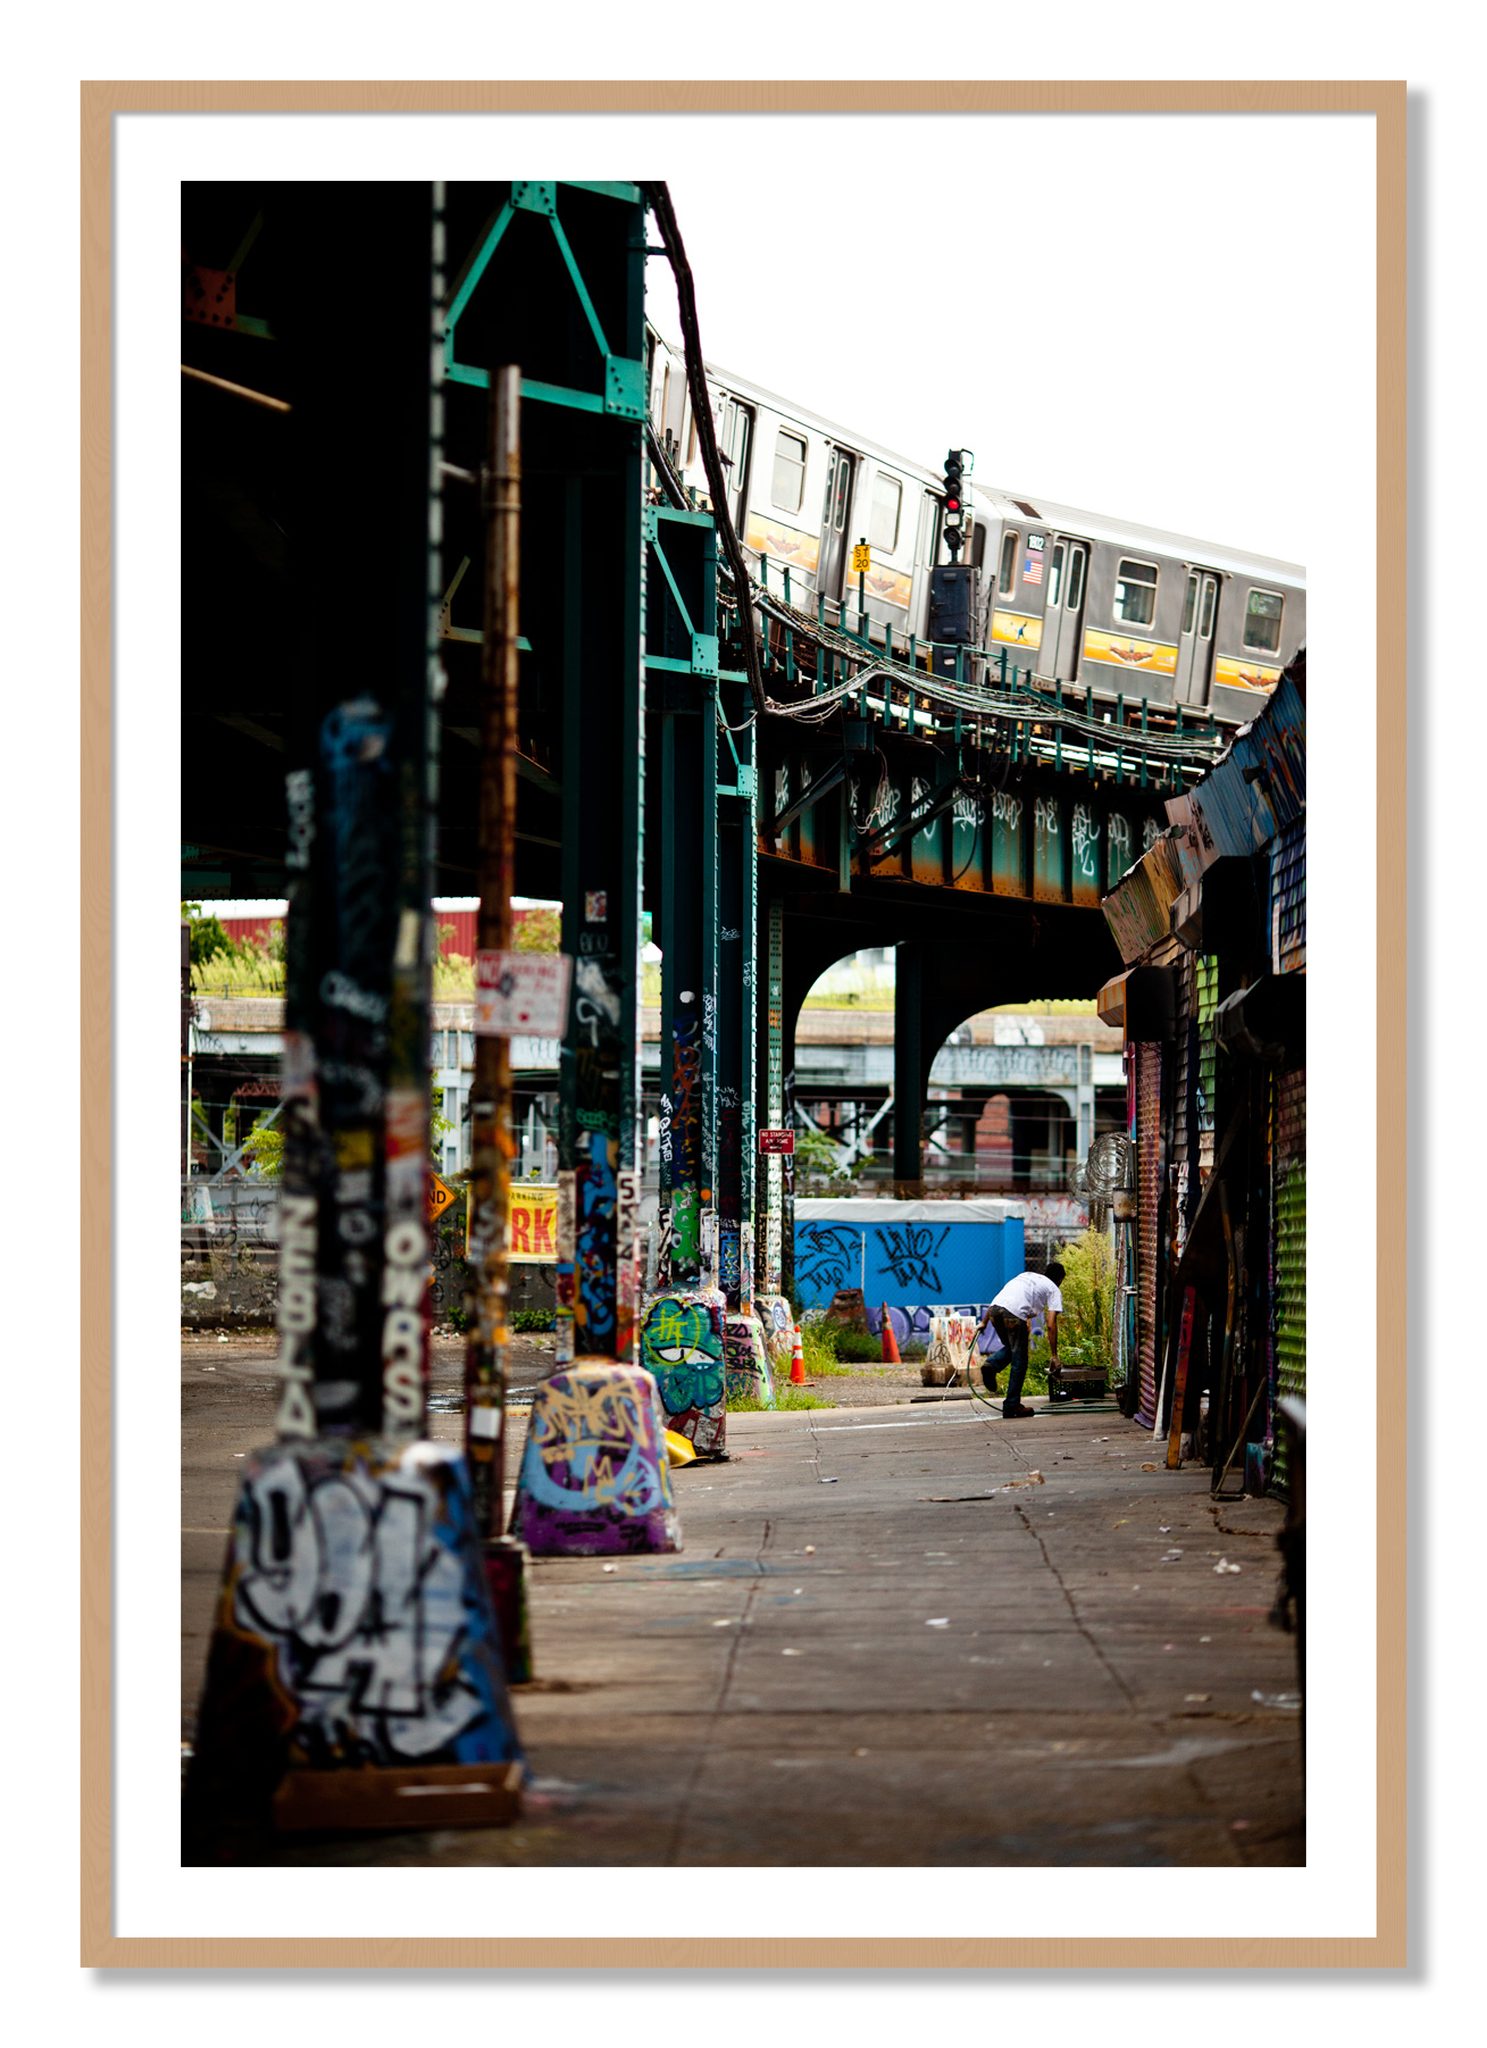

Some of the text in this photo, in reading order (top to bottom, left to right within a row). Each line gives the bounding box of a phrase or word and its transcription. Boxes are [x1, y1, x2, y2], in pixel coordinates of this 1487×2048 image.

[856, 559, 869, 568] 20
[430, 1190, 446, 1204] ND
[511, 1192, 544, 1201] ARKING
[511, 1207, 554, 1253] RK
